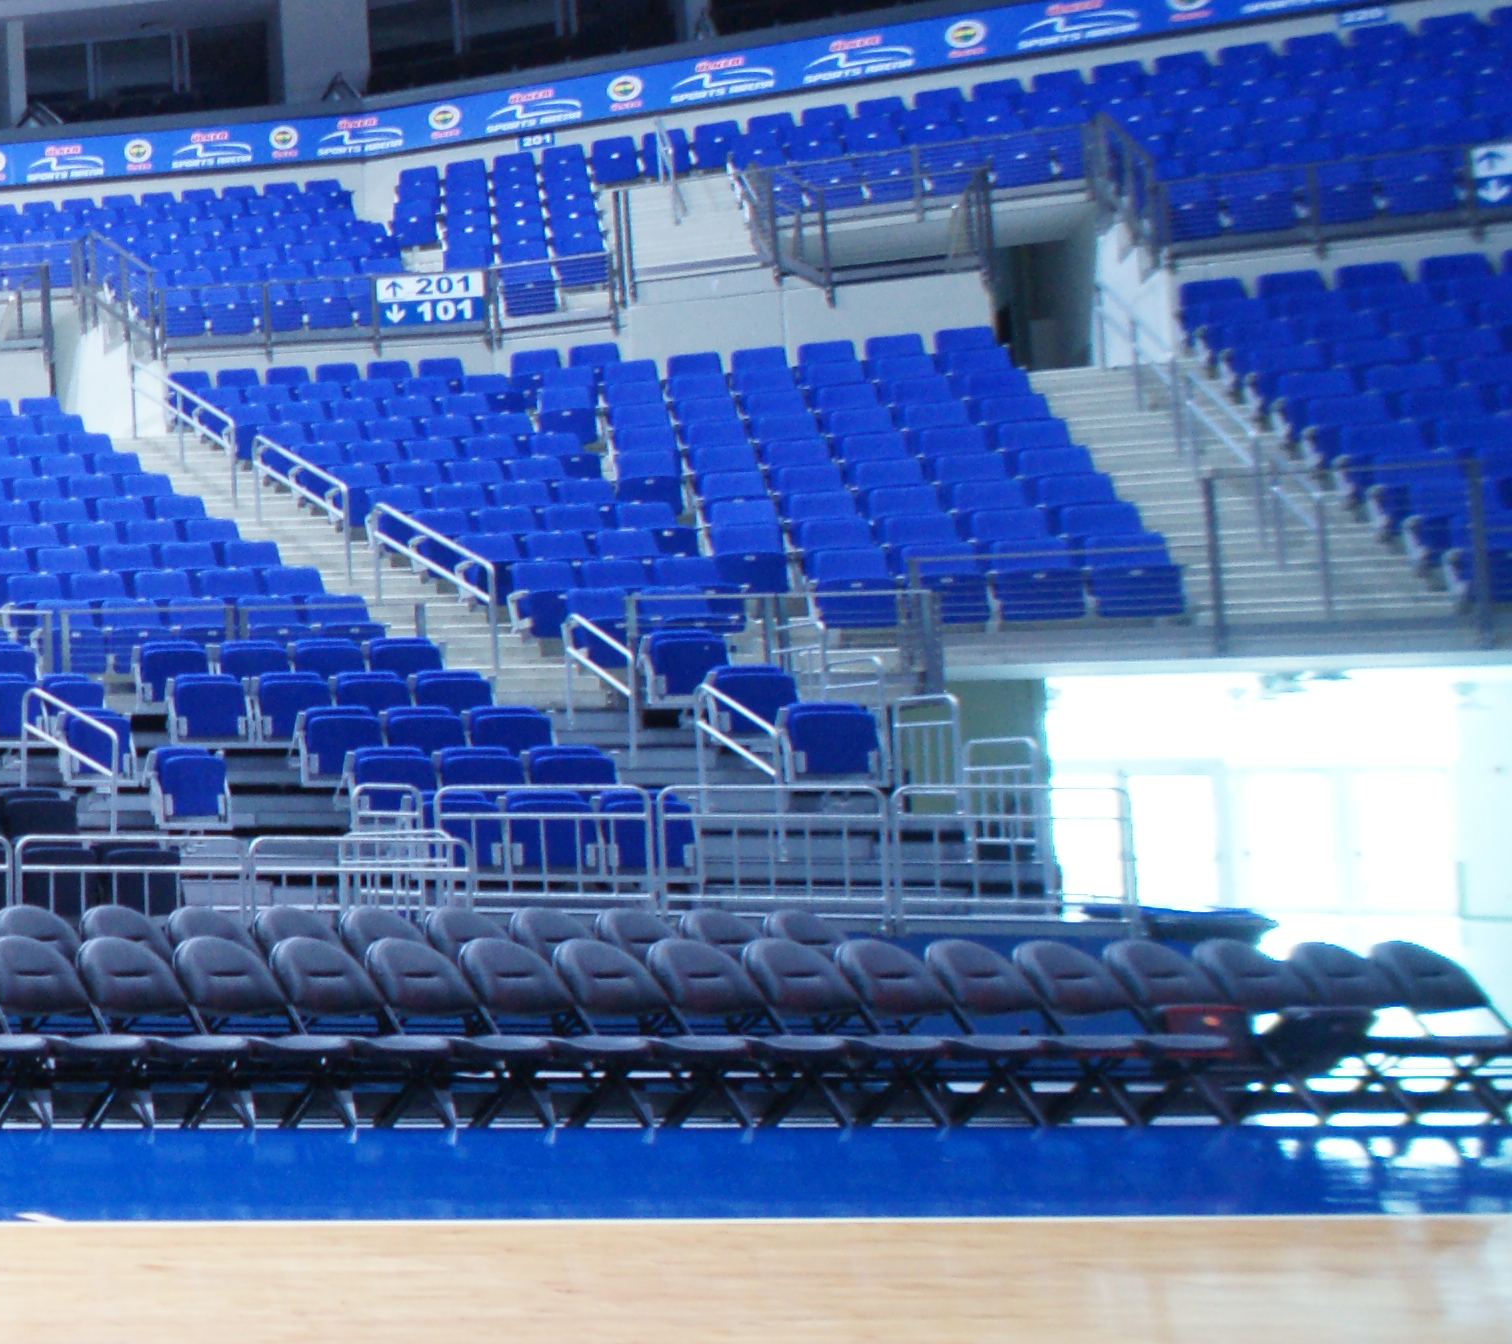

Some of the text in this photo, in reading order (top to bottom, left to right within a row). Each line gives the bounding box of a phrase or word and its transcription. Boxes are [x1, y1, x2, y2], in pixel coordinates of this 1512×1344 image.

[522, 133, 551, 147] 201
[415, 274, 471, 296] 201
[417, 298, 473, 322] 101
